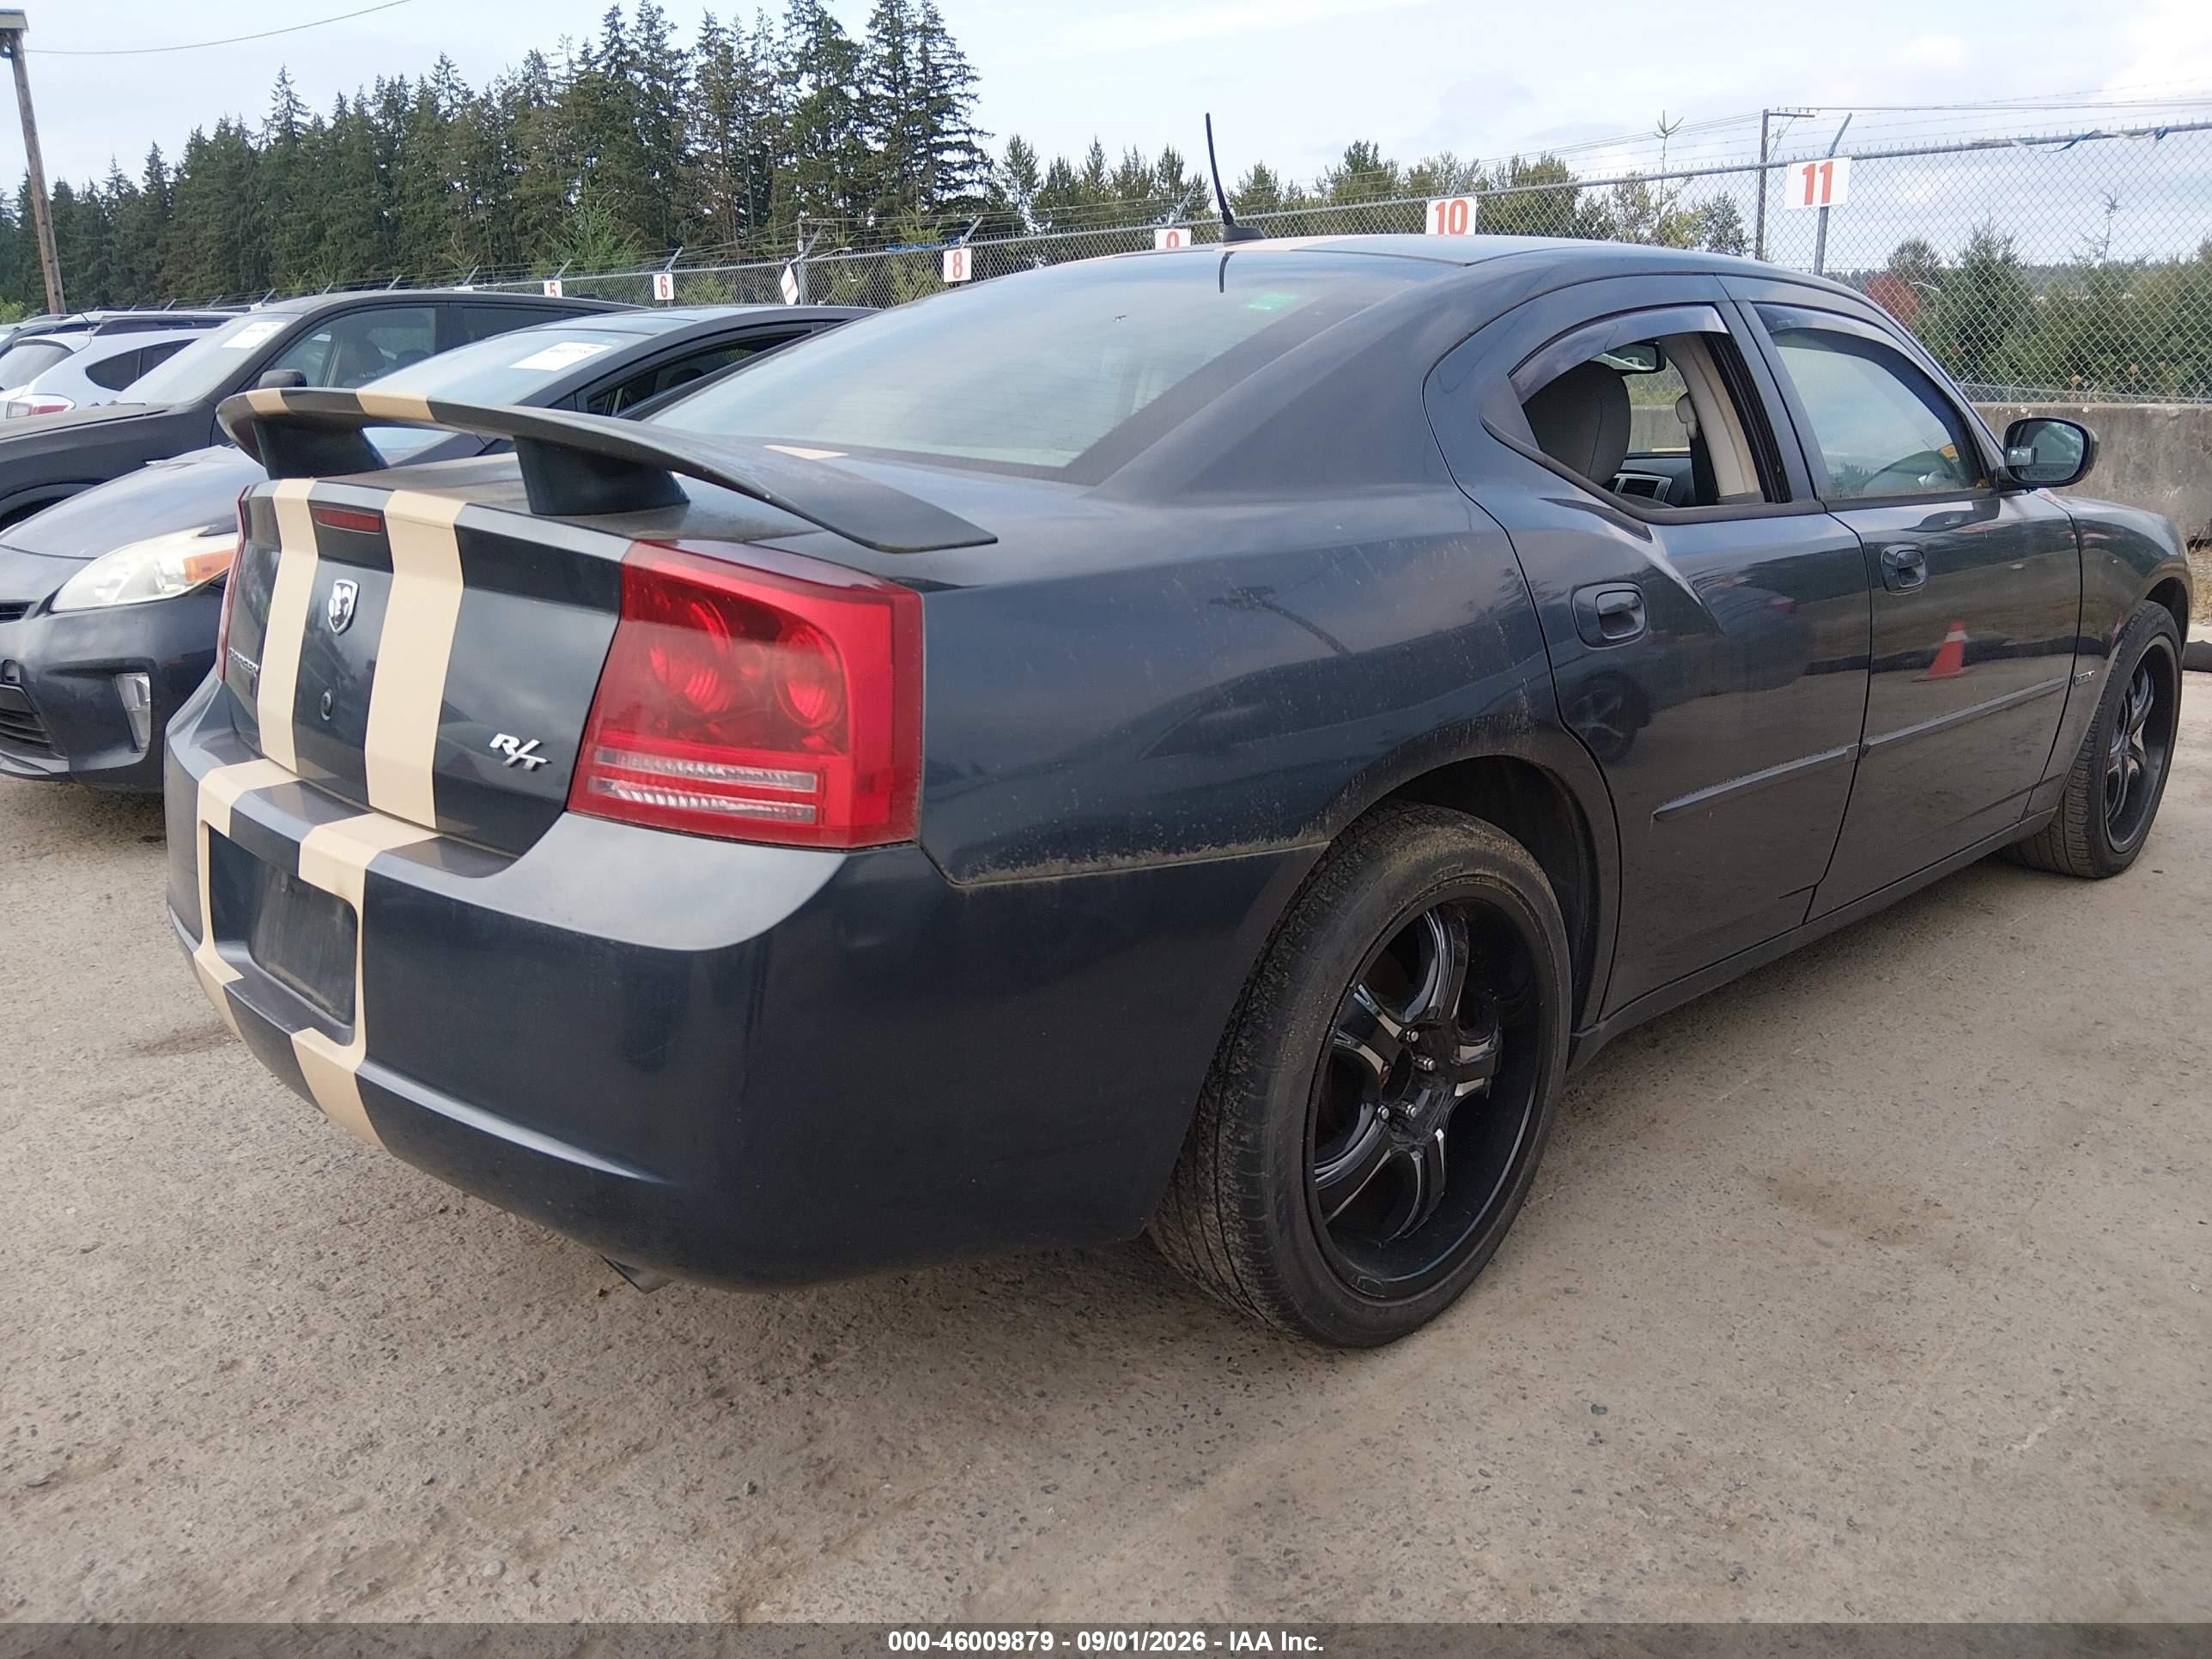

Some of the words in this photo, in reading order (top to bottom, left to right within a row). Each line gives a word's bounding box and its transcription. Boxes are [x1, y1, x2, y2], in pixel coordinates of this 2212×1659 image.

[1802, 161, 1834, 206] 11
[1435, 199, 1468, 234] 10
[952, 251, 963, 279] 8
[549, 282, 557, 297] 5
[659, 275, 668, 299] 6
[489, 732, 548, 770] R/T
